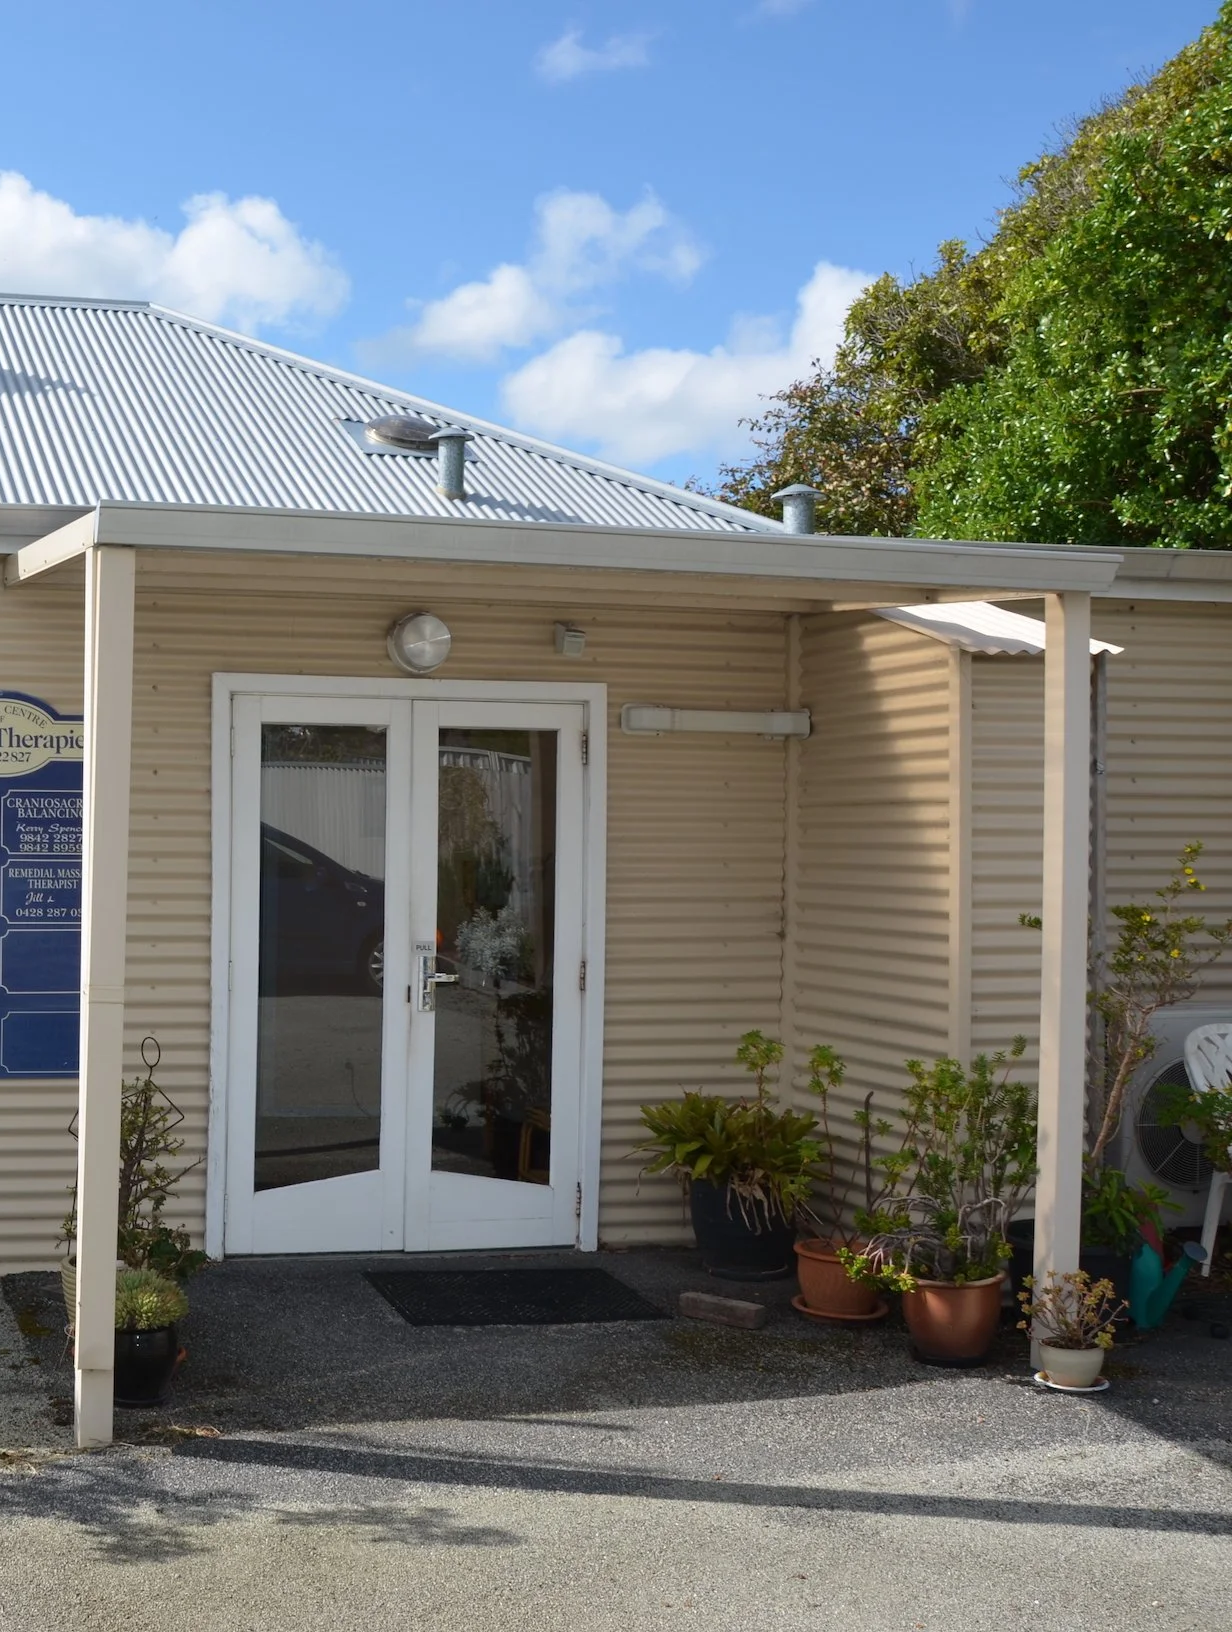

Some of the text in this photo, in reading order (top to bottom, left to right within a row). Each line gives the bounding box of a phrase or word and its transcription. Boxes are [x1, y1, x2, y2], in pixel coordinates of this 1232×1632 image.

[4, 706, 48, 729] CENTRE
[16, 822, 44, 834] Kerry
[20, 834, 49, 842] 9842
[20, 844, 48, 852] 9842
[9, 869, 82, 878] REMEDIAL MASS
[29, 880, 78, 889] THERAPIST
[26, 892, 44, 905] Jill
[16, 908, 43, 917] 0428
[47, 908, 67, 917] 287
